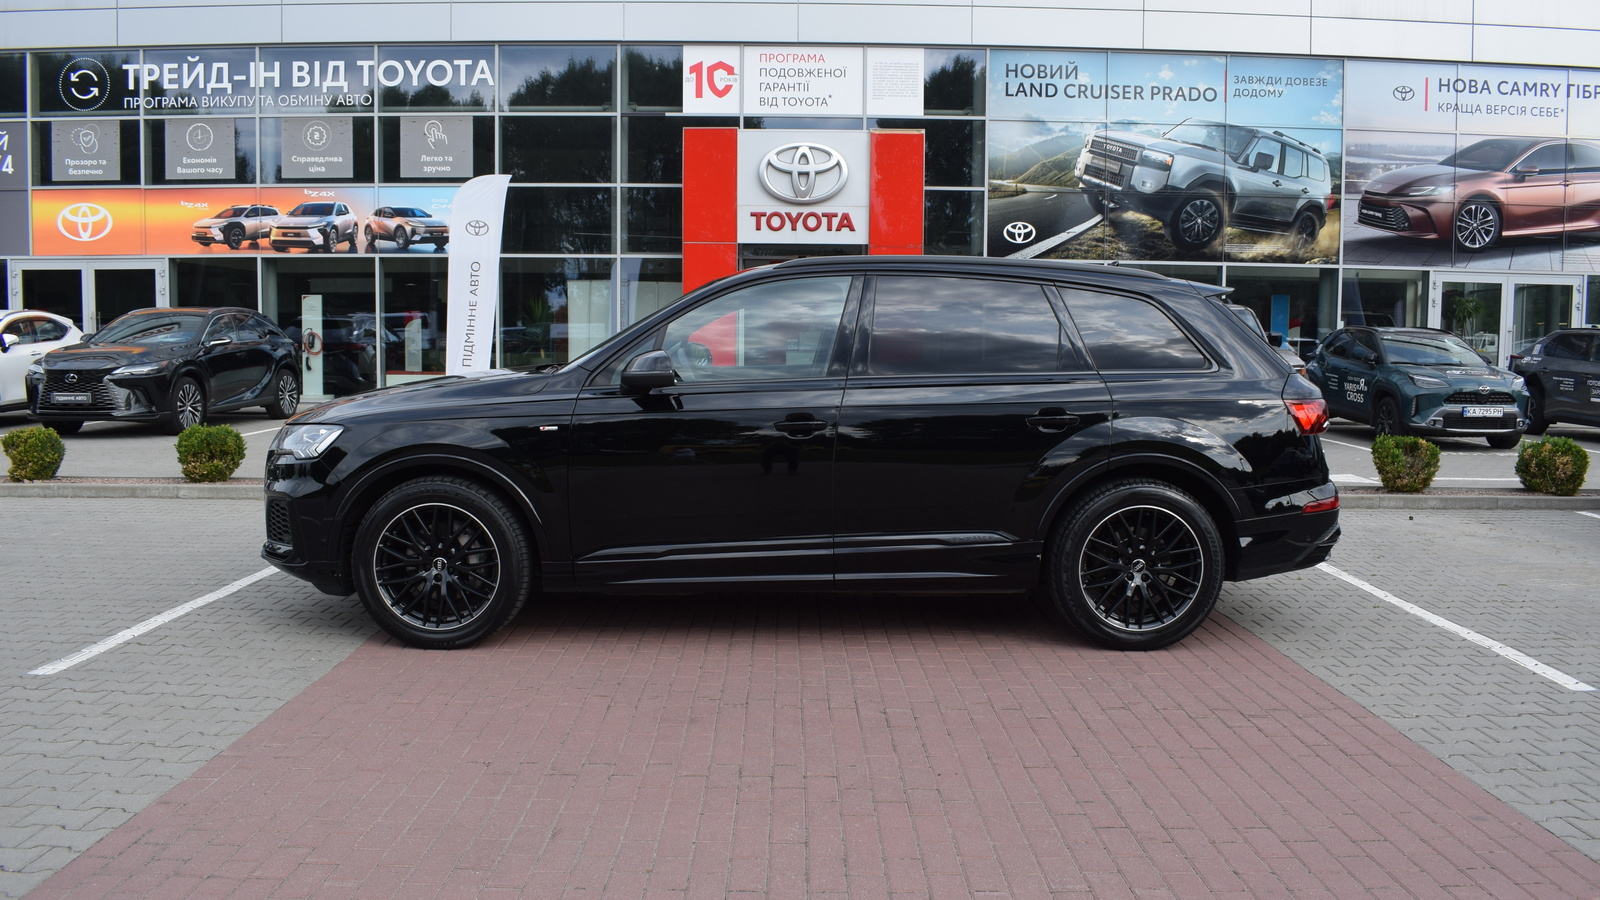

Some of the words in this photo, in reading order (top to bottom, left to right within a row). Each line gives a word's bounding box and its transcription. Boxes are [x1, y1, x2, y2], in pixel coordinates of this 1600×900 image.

[759, 53, 826, 64] ПРОГРАМА
[122, 55, 281, 95] ТРЕЙД-ІН
[291, 60, 349, 93] ВІД
[356, 59, 495, 88] TOYOTA
[759, 66, 847, 80] ПОДОВЖЕНОЇ
[1004, 61, 1079, 80] НОВИЙ
[759, 80, 810, 92] ГАРАНТІЇ
[1233, 74, 1284, 87] ЗАВЖДИ
[1285, 76, 1328, 88] ДОВЕЗЕ
[1437, 77, 1492, 96] НОВА
[1497, 80, 1562, 98] CAMRY
[1004, 81, 1058, 98] LAND
[1063, 83, 1145, 101] CRUISER
[1150, 85, 1218, 103] PRADO
[1233, 87, 1284, 99] ДОДОМУ
[124, 97, 198, 109] ПРОГРАМА
[202, 95, 256, 108] ВИКУПУ
[259, 95, 275, 107] ТА
[278, 94, 334, 107] ОБМІНУ
[336, 93, 373, 106] АВТО
[759, 97, 779, 108] ВІД
[1437, 102, 1483, 115] КРАЩА
[1485, 104, 1527, 116] ВЕРСІЯ
[0, 154, 15, 175] 4
[65, 158, 98, 167] Прозоро
[291, 155, 343, 164] Справедлива
[420, 155, 443, 163] Легко
[68, 168, 104, 176] безпечно
[176, 166, 206, 174] Вашого
[207, 167, 224, 175] часу
[308, 164, 326, 173] ціна
[422, 165, 451, 174] зручно
[750, 211, 856, 232] TOYOTA
[469, 261, 481, 297] АВТО
[461, 300, 478, 367] ПІДМІННЕ
[1346, 391, 1365, 403] CROSS
